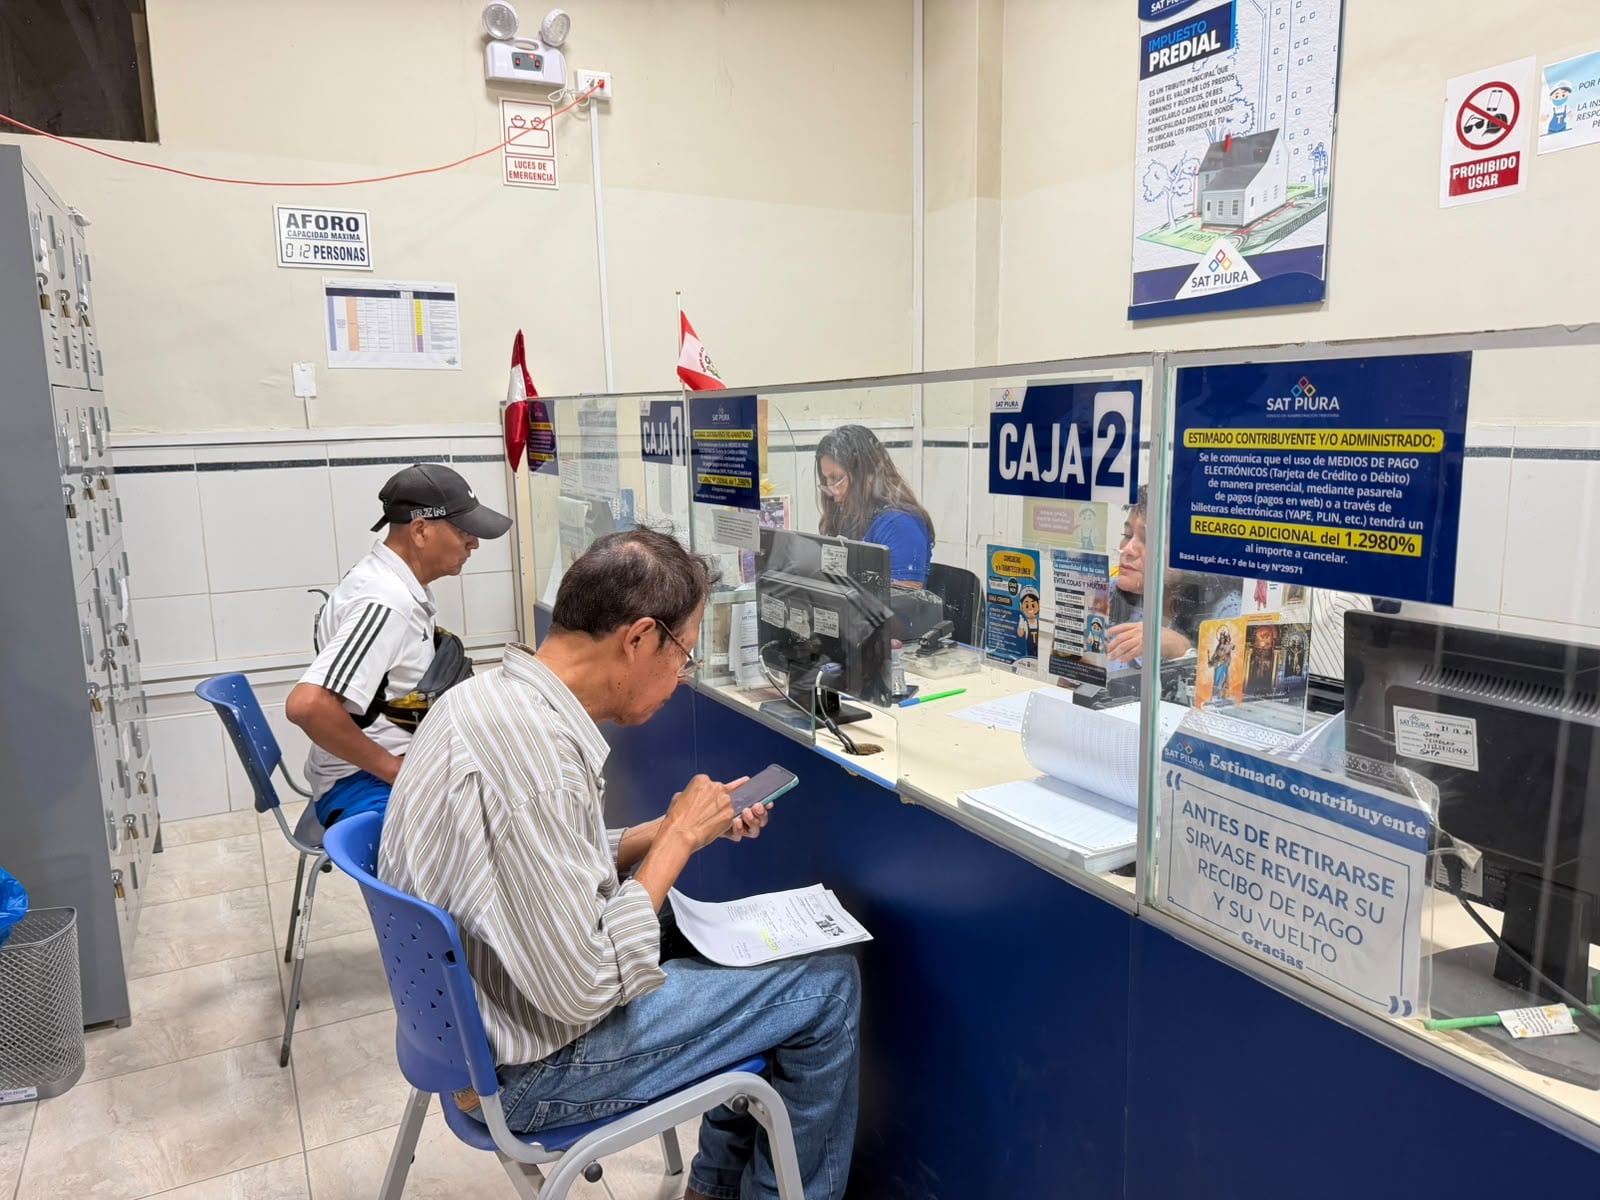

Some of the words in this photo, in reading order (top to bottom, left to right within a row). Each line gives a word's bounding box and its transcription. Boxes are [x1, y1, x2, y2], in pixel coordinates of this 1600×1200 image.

[1148, 20, 1208, 52] IMPUESTO
[1149, 29, 1221, 72] PREDIAL
[1149, 89, 1156, 97] ES
[1156, 87, 1164, 95] UN
[1165, 80, 1186, 92] TRIBUTO
[1187, 70, 1215, 85] MUNICIPAL
[1216, 65, 1229, 75] QUE
[1149, 96, 1165, 106] GRAVA
[1173, 88, 1190, 99] VALOR
[1191, 85, 1199, 93] DE
[1200, 81, 1210, 90] LOS
[1211, 73, 1235, 86] PREDIOS
[1579, 79, 1596, 90] POR
[1148, 103, 1172, 116] URBANOS
[1205, 87, 1223, 99] DEBES
[1148, 110, 1180, 125] CANCELARLO
[1181, 104, 1197, 116] CADA
[1197, 99, 1209, 111] AÑO
[1210, 98, 1218, 107] EN
[1219, 96, 1226, 104] LA
[1577, 102, 1587, 111] LA
[1147, 136, 1154, 144] SE
[1155, 131, 1174, 142] UBICAN
[1174, 127, 1185, 136] LOS
[1185, 121, 1208, 133] PREDIOS
[1208, 118, 1216, 126] DE
[1217, 116, 1225, 124] TU
[1148, 117, 1186, 135] MUNICIPALIDAD
[1187, 110, 1213, 124] DISTRITAL
[1214, 104, 1234, 116] DONDE
[509, 170, 553, 181] EMERGENCIA
[514, 160, 536, 170] LUCES
[538, 163, 547, 171] DE
[1452, 155, 1517, 180] PROHIBIDO
[1468, 173, 1499, 190] USAR
[286, 213, 360, 232] AFORO
[287, 230, 328, 239] CAPACIDAD
[331, 232, 360, 241] MAXIMA
[313, 245, 366, 262] PERSONAS
[1191, 275, 1211, 288] SAT
[1213, 270, 1249, 286] PIURA
[1266, 397, 1291, 411] SAT
[1295, 396, 1340, 411] PIURA
[643, 421, 671, 456] CAJA
[673, 416, 679, 457] 1
[999, 422, 1085, 485] CAJA
[1095, 410, 1127, 488] 2
[1188, 432, 1233, 444] ESTIMADO
[1235, 432, 1316, 446] CONTRIBUYENTE
[1318, 433, 1338, 446] Y/O
[1340, 433, 1435, 448] ADMINISTRADO:
[1199, 452, 1209, 463] Se
[1210, 452, 1219, 463] le
[1220, 453, 1261, 464] comunica
[1263, 456, 1281, 467] que
[1283, 454, 1291, 465] el
[1293, 456, 1311, 466] uso
[1313, 455, 1326, 466] de
[1327, 456, 1368, 468] MEDIOS
[1370, 457, 1385, 468] DE
[1387, 457, 1419, 469] PAGO
[1204, 464, 1268, 478] ELECTRÓNICOS
[1269, 468, 1305, 481] (Tarjeta
[1306, 469, 1320, 480] de
[1321, 470, 1358, 482] Crédito
[1360, 473, 1368, 482] o
[1370, 471, 1410, 486] Débito)
[1208, 478, 1219, 488] de
[1220, 480, 1253, 490] manera
[1255, 481, 1304, 493] presencial,
[1306, 484, 1355, 496] mediante
[1356, 487, 1403, 499] pasarela
[1215, 491, 1226, 501] de
[1227, 493, 1253, 504] pagos
[1254, 494, 1284, 507] (pagos
[1285, 496, 1298, 506] en
[1300, 496, 1324, 509] web)
[1325, 499, 1332, 509] o
[1334, 500, 1341, 509] a
[1343, 499, 1376, 512] través
[1378, 502, 1392, 513] de
[1190, 502, 1229, 514] billeteras
[1230, 506, 1284, 518] electrónicas
[1285, 510, 1314, 522] (YAPE,
[1316, 511, 1342, 525] PLIN,
[1344, 514, 1367, 528] etc.)
[1369, 516, 1406, 529] tendrá
[1408, 520, 1424, 530] un
[1194, 520, 1246, 536] RECARGO
[1249, 525, 1317, 543] ADICIONAL
[1320, 532, 1340, 545] del
[1344, 531, 1416, 554] 1.2980%
[1179, 552, 1195, 561] Base
[1196, 554, 1216, 564] Legal:
[1217, 556, 1230, 566] Art.
[1231, 558, 1237, 566] 7
[1237, 559, 1247, 567] de
[1248, 560, 1256, 568] la
[1257, 560, 1270, 572] Ley
[1245, 543, 1254, 553] al
[1255, 544, 1293, 557] importe
[1294, 549, 1301, 558] a
[1303, 551, 1349, 564] cancelar.
[1164, 747, 1179, 759] SAT
[1180, 752, 1205, 769] PIURA
[1209, 753, 1286, 790] Estimado
[1289, 783, 1427, 839] contribuyente
[1182, 799, 1239, 836] ANTES
[1244, 823, 1270, 850] DE
[1275, 836, 1395, 899] RETIRARSE
[1185, 826, 1256, 871] SIRVASE
[1261, 858, 1349, 911] REVISAR
[1354, 897, 1385, 924] SU
[1198, 857, 1263, 901] RECIBO
[1269, 890, 1297, 917] DE
[1302, 904, 1363, 946] PAGO
[1213, 891, 1225, 911] Y
[1228, 900, 1253, 923] SU
[1257, 911, 1338, 963] VUELTO
[1241, 931, 1304, 970] Gracias
